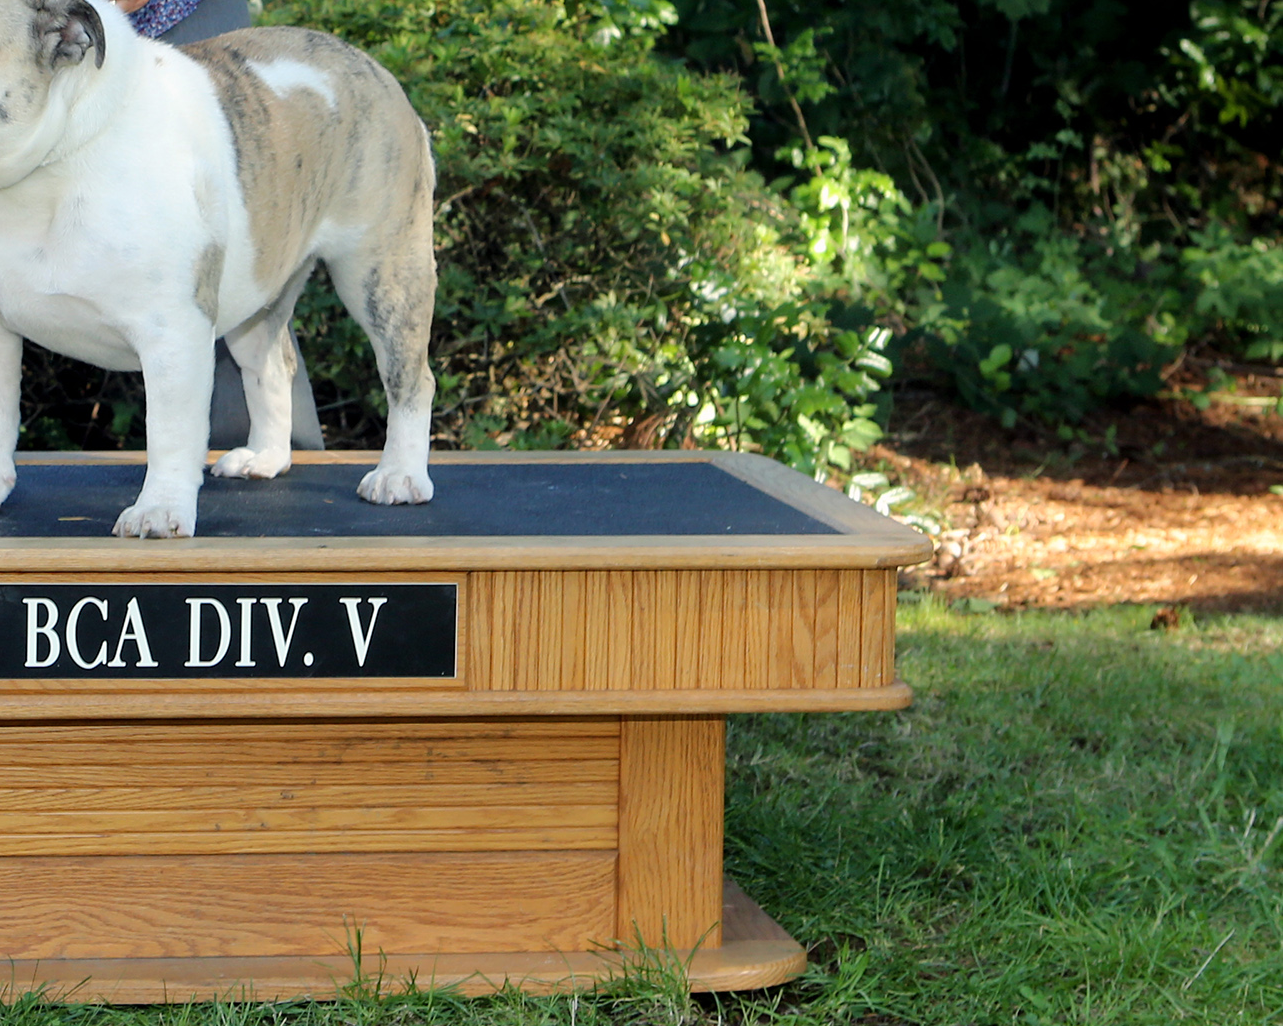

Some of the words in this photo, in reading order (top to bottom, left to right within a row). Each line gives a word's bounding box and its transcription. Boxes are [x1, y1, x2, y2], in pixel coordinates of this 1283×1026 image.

[22, 596, 158, 669] BCA
[184, 597, 314, 668] DIV.
[339, 597, 388, 667] V
